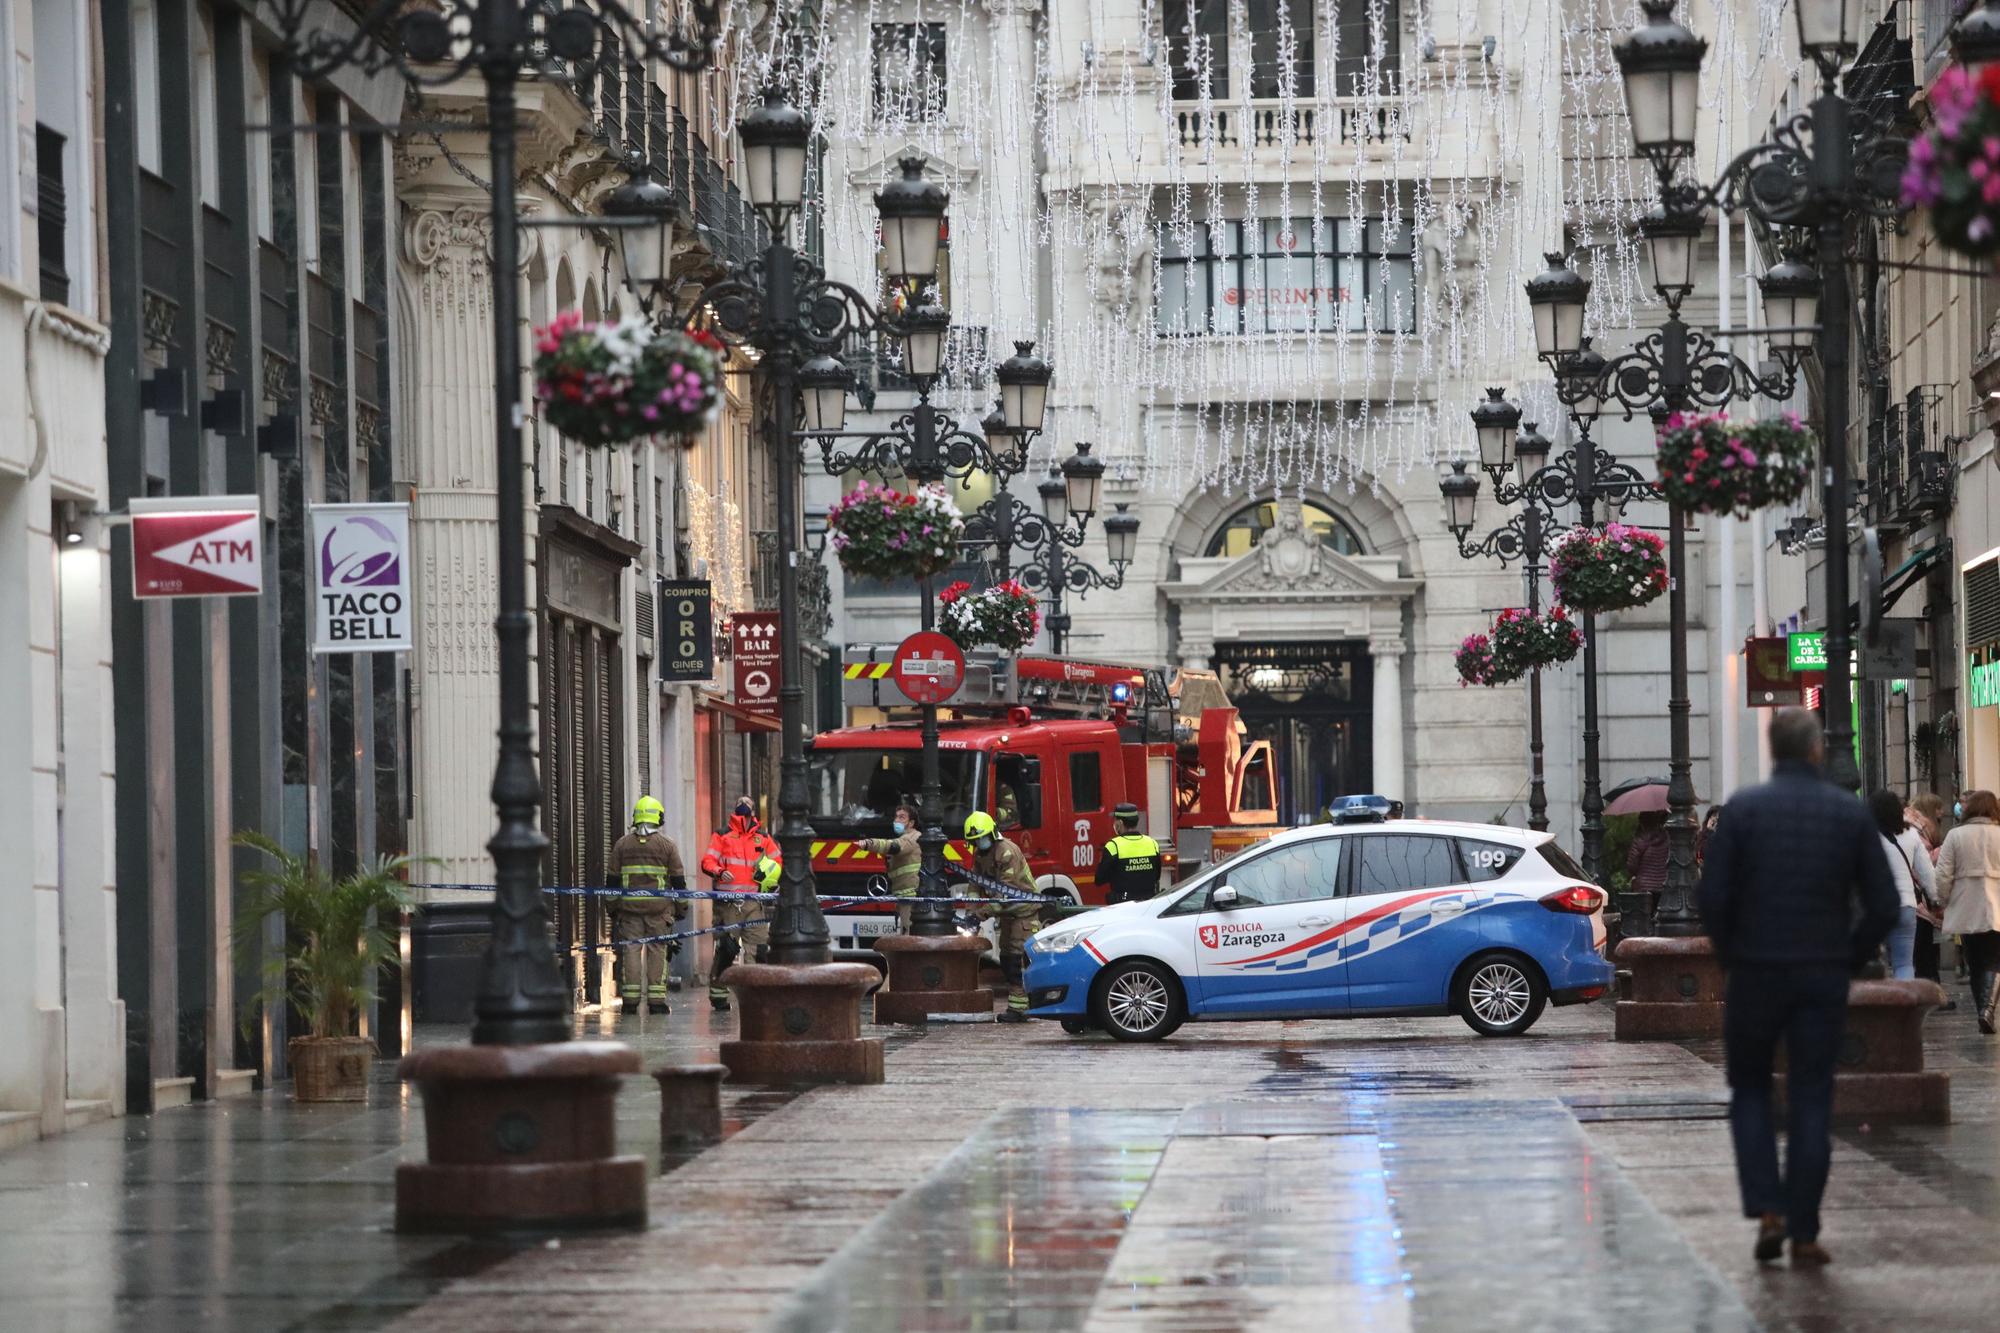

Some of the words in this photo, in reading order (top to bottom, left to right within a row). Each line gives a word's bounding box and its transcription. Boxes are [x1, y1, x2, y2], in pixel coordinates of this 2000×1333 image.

[188, 540, 253, 565] ATM
[664, 588, 709, 597] COMPRO
[322, 592, 402, 615] TACO
[329, 617, 402, 640] BELL
[678, 599, 696, 657] ORO
[744, 640, 770, 651] BAR
[1798, 638, 1811, 646] LA
[1801, 647, 1814, 655] DE
[672, 660, 704, 669] GINES
[1073, 844, 1094, 867] 080
[1129, 857, 1149, 865] POLICIA
[1471, 850, 1506, 868] 199
[1125, 864, 1153, 872] ZARAGOZA
[859, 924, 879, 934] 8949
[1221, 922, 1263, 933] POLICIA
[1222, 932, 1286, 948] Zaragoza
